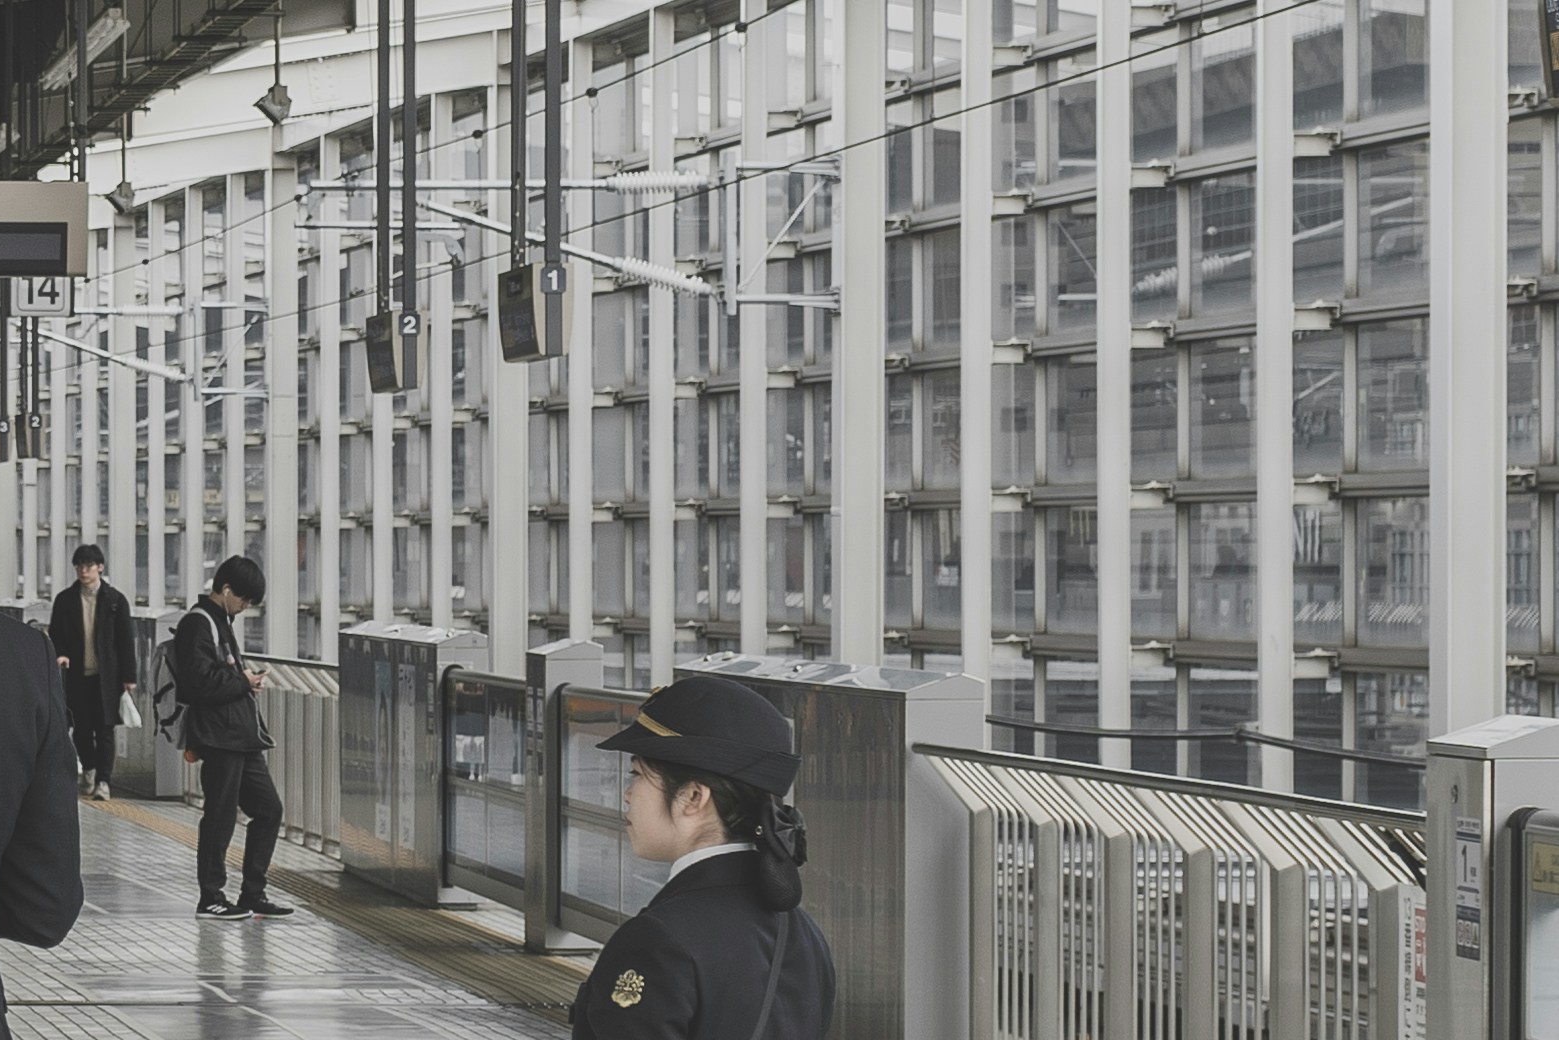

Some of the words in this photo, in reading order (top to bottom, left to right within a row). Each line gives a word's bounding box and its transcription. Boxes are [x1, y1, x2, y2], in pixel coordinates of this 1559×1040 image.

[547, 269, 558, 291] 1
[22, 277, 60, 305] 14
[403, 315, 417, 334] 2
[0, 421, 9, 433] 3
[32, 415, 40, 428] 2
